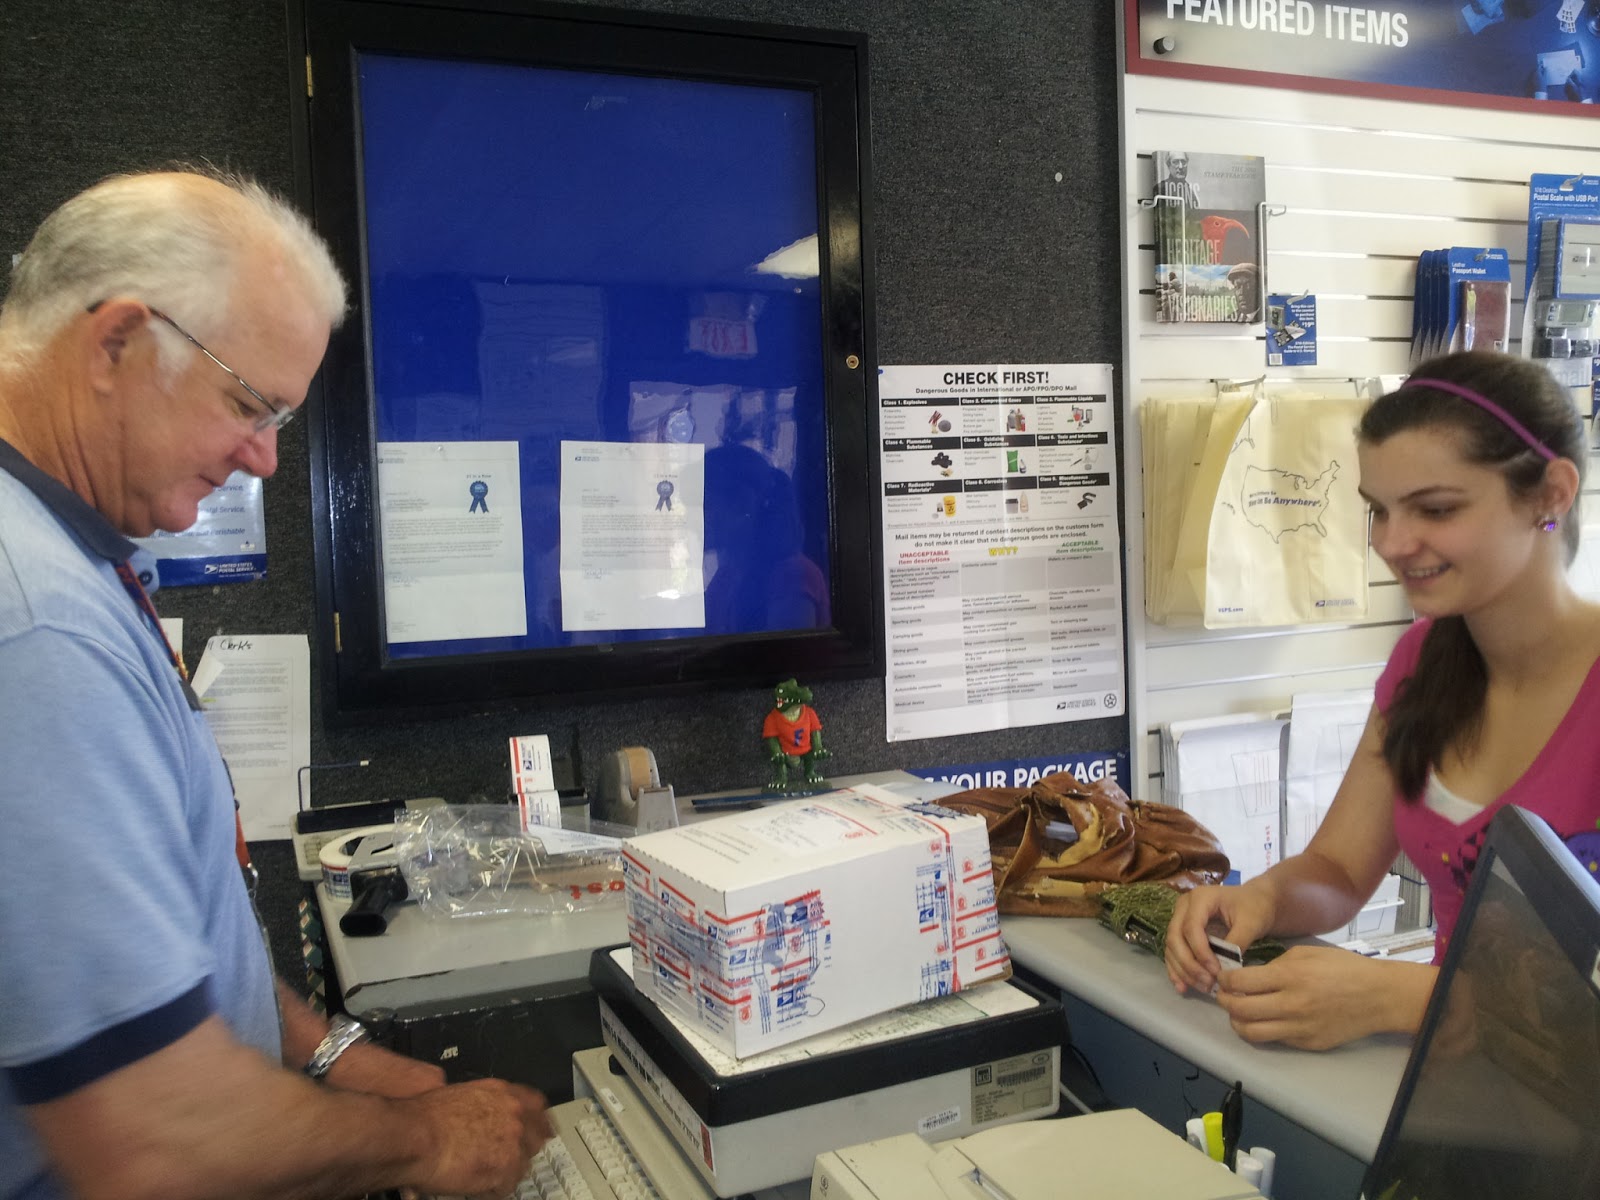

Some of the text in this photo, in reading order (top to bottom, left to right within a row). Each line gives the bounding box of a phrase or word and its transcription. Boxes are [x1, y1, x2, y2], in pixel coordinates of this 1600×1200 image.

[1167, 0, 1409, 48] FEATURED ITEMS
[1165, 181, 1201, 210] ICONS
[1533, 193, 1599, 203] Postal Scale with USB Port
[1166, 238, 1221, 265] HERITAGE
[1168, 295, 1239, 322] VISIONARIES
[943, 371, 1049, 385] CHECK FIRST!
[981, 397, 1008, 405] Compressed
[928, 532, 942, 540] may
[1009, 526, 1045, 534] descriptions
[999, 535, 1030, 543] dangerous
[1061, 540, 1099, 548] ACCEPTABLE
[899, 550, 949, 558] UNACCEPTABLE
[988, 546, 1018, 556] WHY?
[913, 557, 950, 565] descriptions
[793, 728, 804, 747] F
